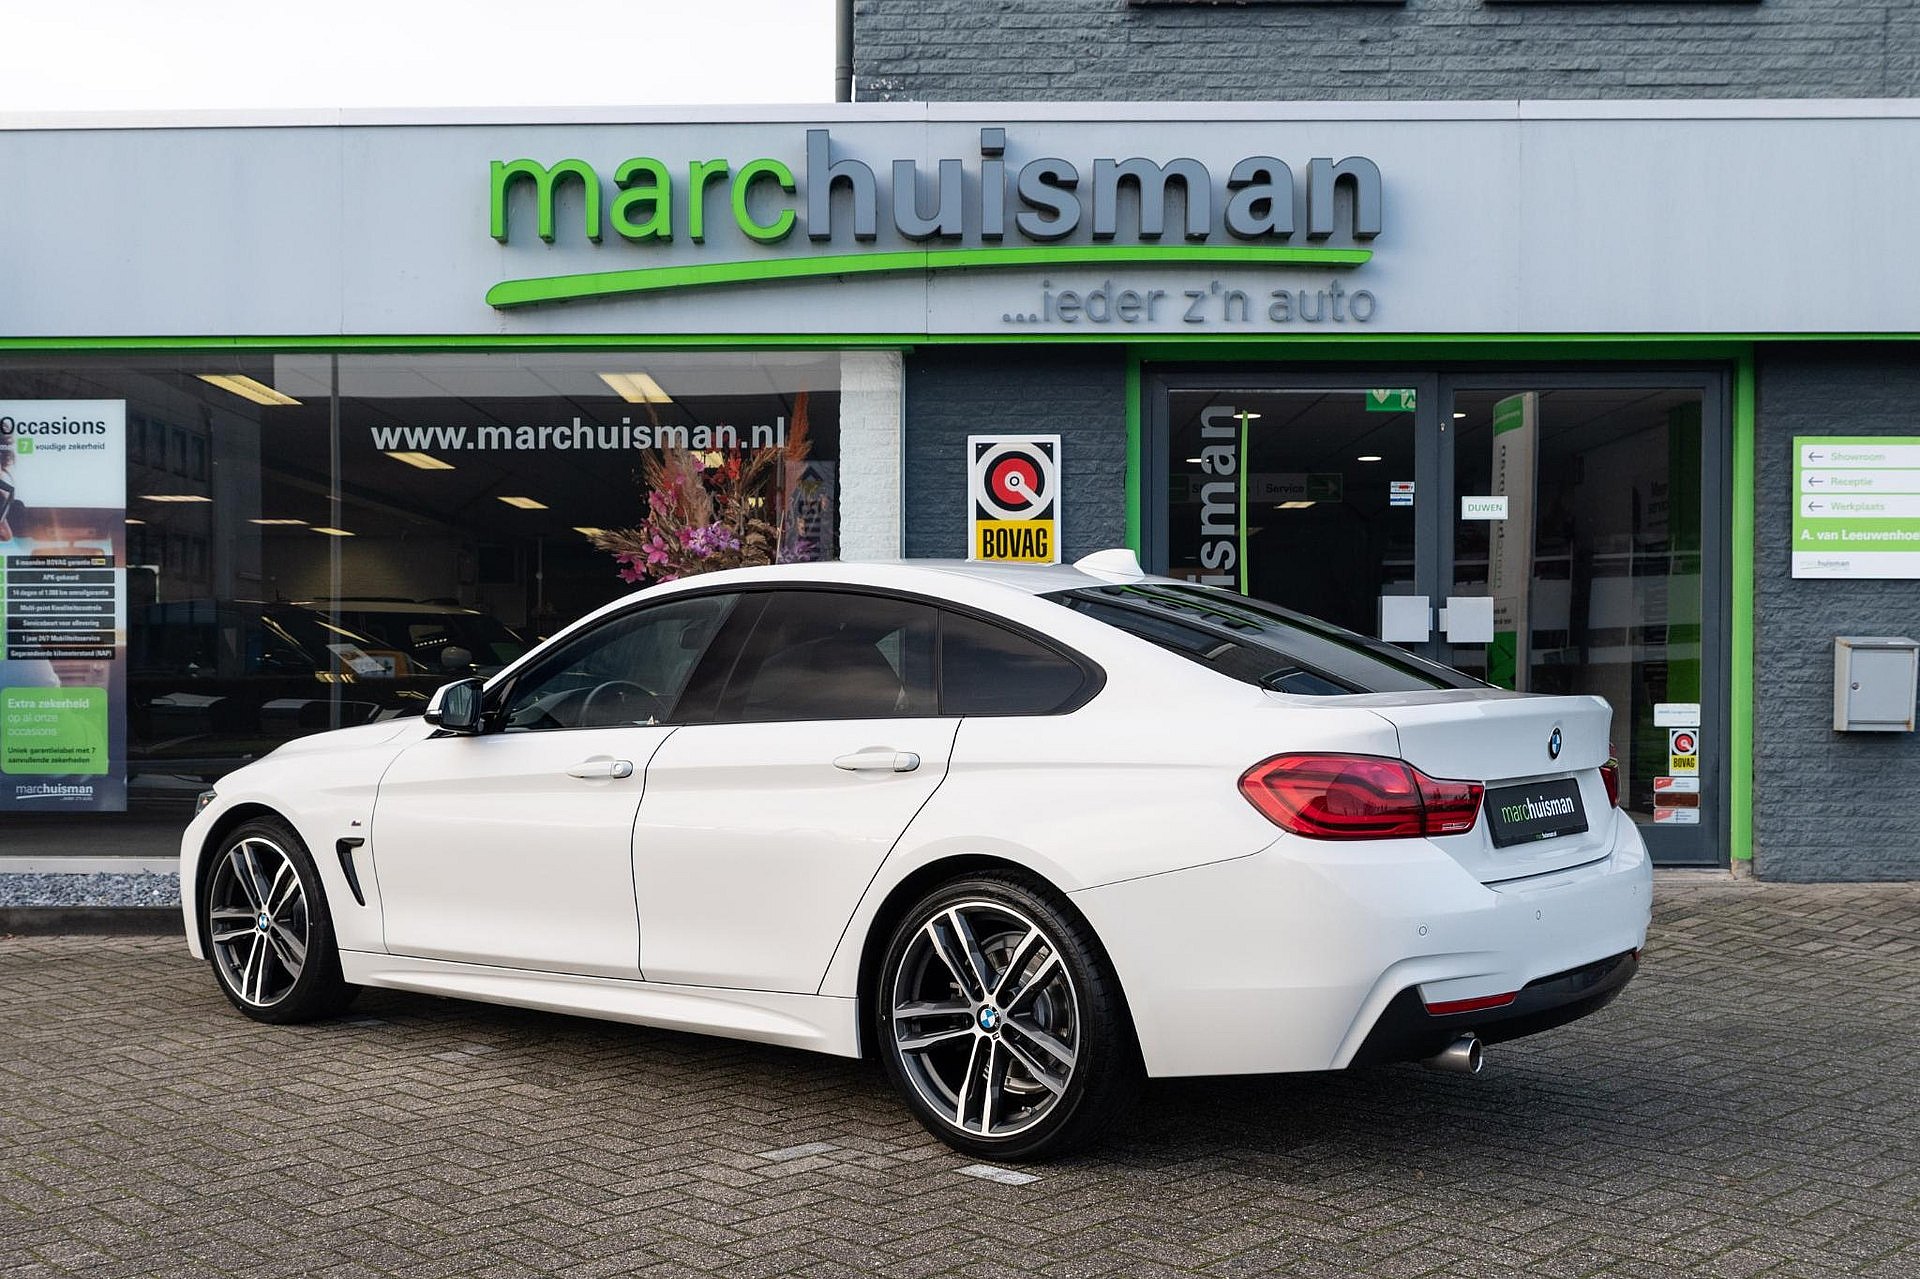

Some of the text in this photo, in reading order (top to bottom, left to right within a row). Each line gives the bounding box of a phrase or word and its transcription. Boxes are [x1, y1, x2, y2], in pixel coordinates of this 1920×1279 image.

[489, 127, 1382, 244] marchuisman
[1183, 279, 1249, 323] z'n
[1268, 279, 1378, 323] auto
[0, 417, 106, 435] Occasions
[371, 417, 786, 450] www.marchuisman.nl
[35, 442, 67, 451] voudige
[68, 442, 105, 450] zekerheid
[1830, 476, 1874, 488] Receptie
[1467, 503, 1504, 513] DUWEN
[1830, 501, 1886, 513] Werkplaats
[1801, 529, 1815, 540] A.
[1817, 532, 1839, 540] van
[982, 527, 1049, 559] BOVAG
[7, 698, 90, 708] Extra zekerheid
[1673, 757, 1696, 768] BOVAG
[15, 783, 94, 794] marchuisman
[1501, 795, 1576, 824] marchuisman
